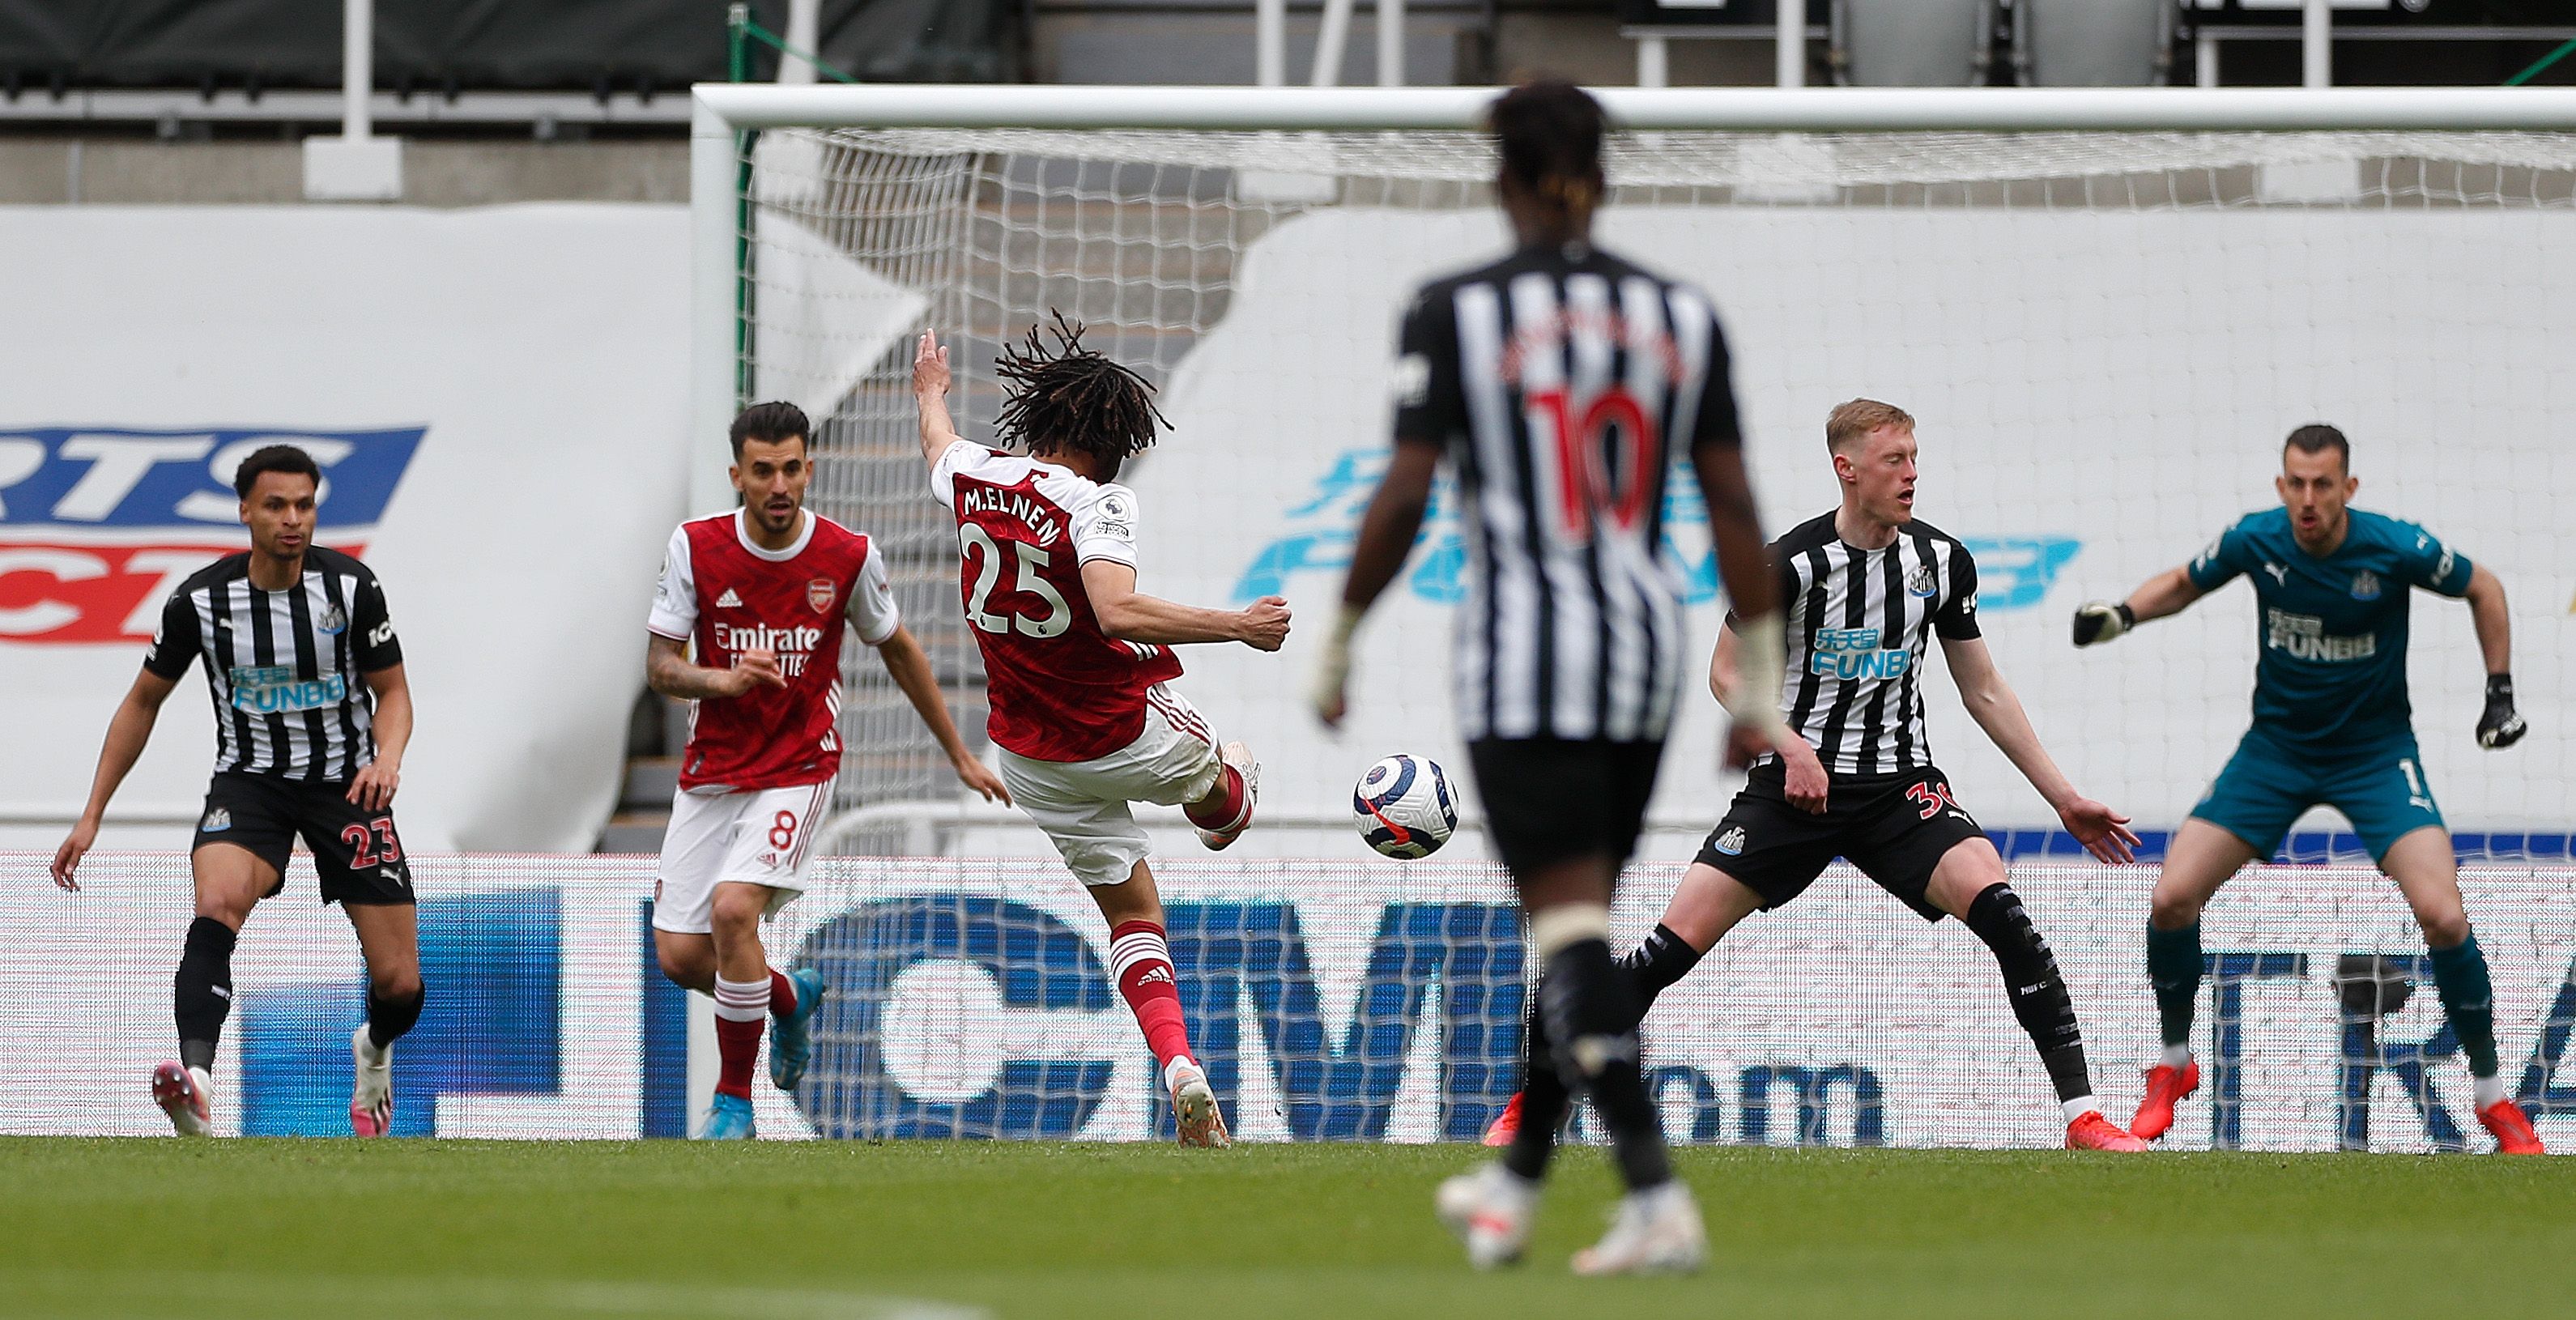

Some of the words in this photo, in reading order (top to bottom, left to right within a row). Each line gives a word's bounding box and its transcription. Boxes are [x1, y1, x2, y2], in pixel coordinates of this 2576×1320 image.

[1526, 389, 1662, 543] 10
[960, 522, 1071, 638] 25
[713, 620, 825, 652] Emirate
[2398, 757, 2422, 796] 1
[341, 817, 400, 871] 23
[769, 810, 797, 851] 8
